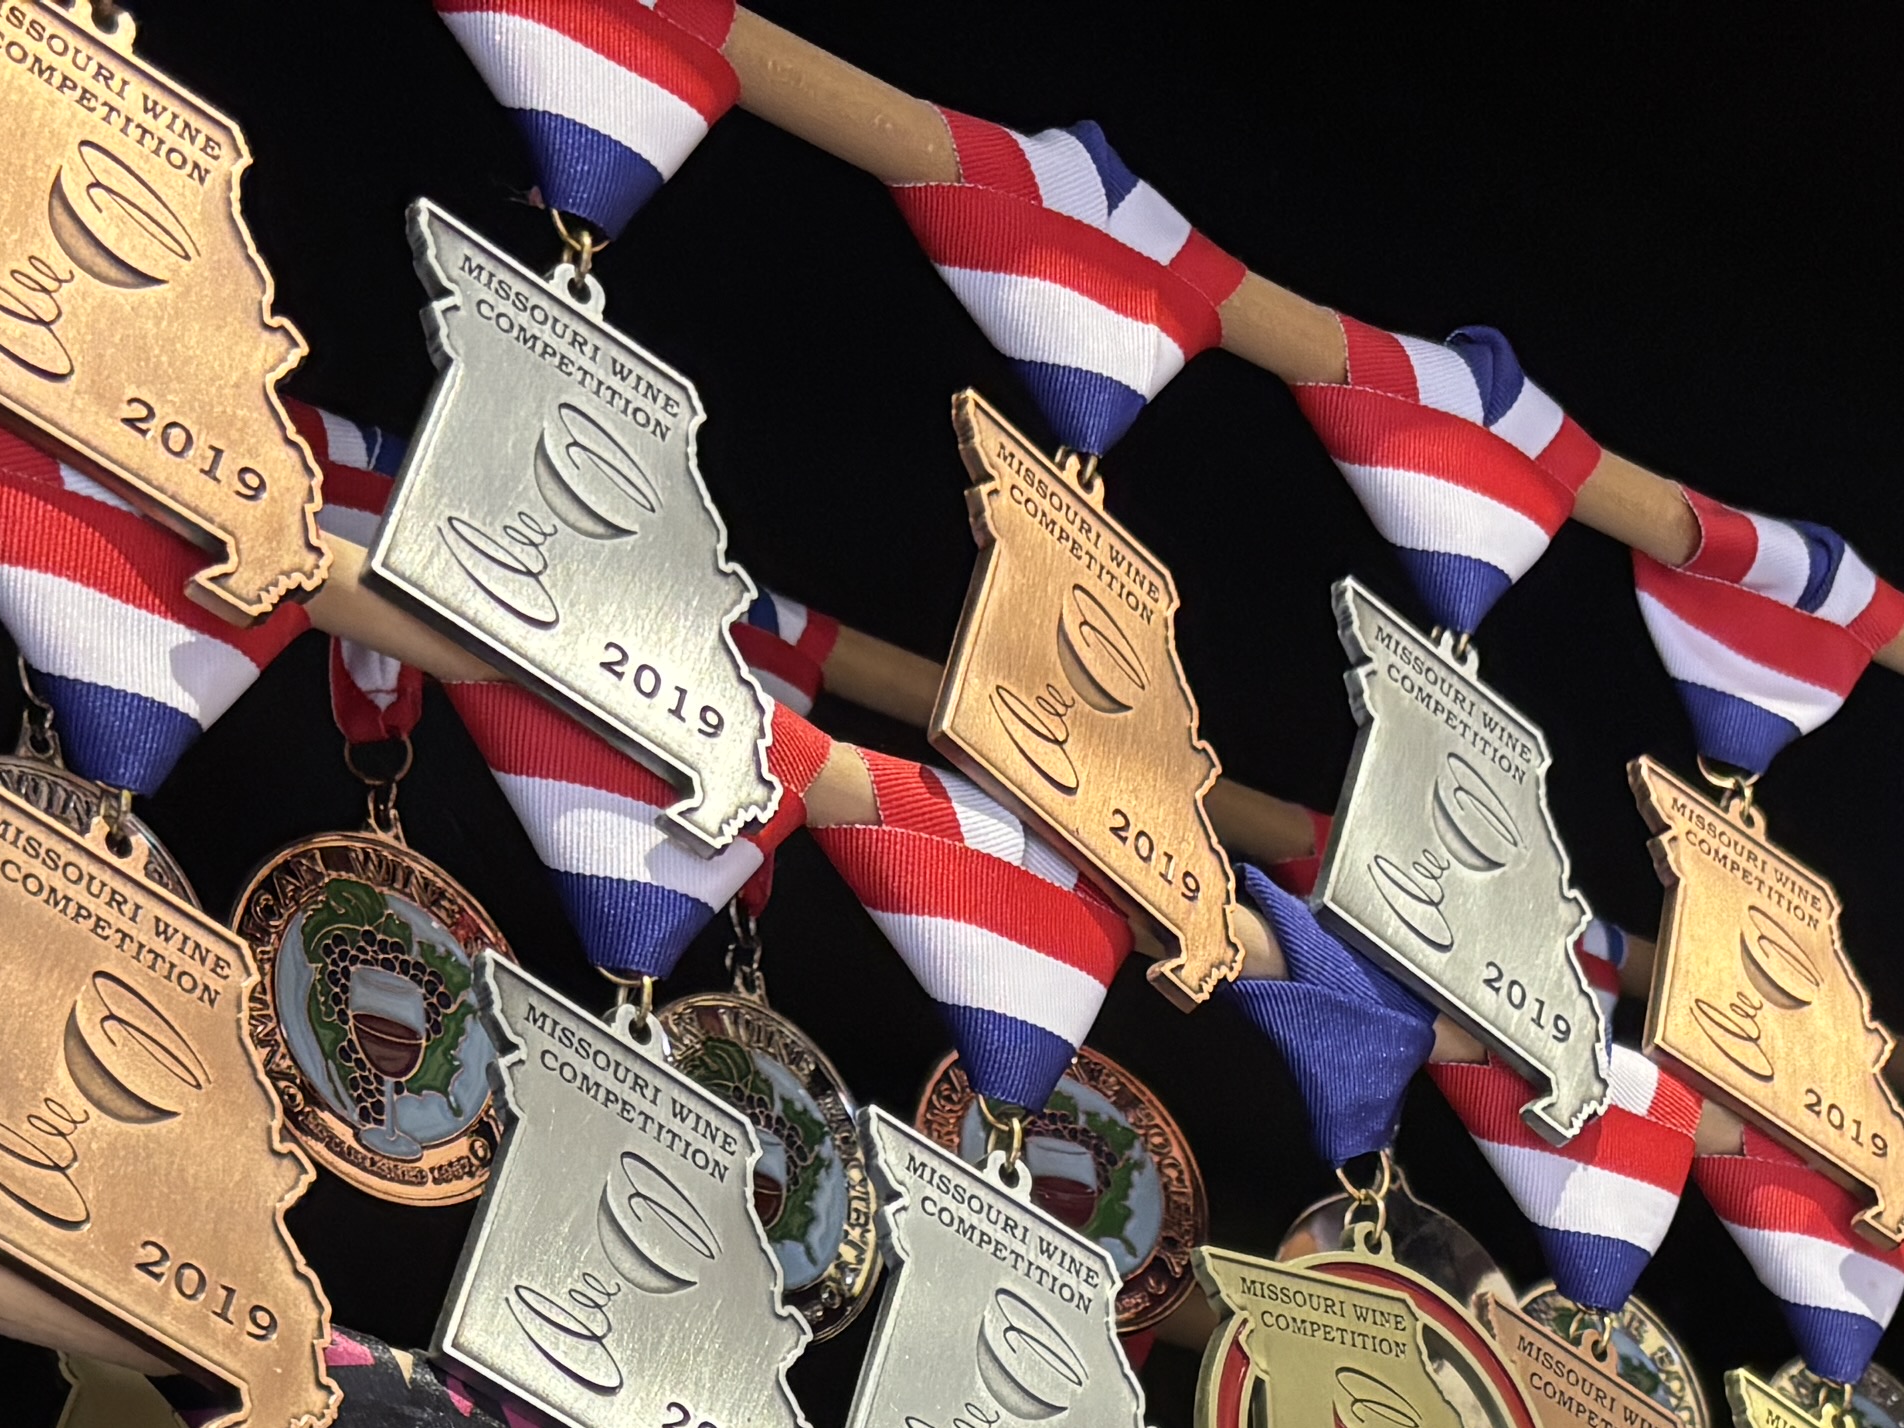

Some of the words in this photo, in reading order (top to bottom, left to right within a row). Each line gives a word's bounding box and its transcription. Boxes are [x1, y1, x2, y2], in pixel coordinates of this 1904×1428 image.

[140, 90, 223, 162] WINE
[458, 252, 602, 366] MISSOURI
[608, 352, 680, 418] WINE
[476, 299, 671, 444] COMPETITION
[119, 397, 269, 504] 2019
[996, 441, 1105, 555] MISSOURI
[1107, 540, 1162, 604] WINE
[1009, 484, 1155, 622] COMPETITION
[598, 642, 726, 740] 2019
[1375, 625, 1479, 719] MISSOURI
[1481, 708, 1532, 762] WINE
[1387, 664, 1527, 785] COMPETITION
[1110, 809, 1201, 902] 2019
[1670, 798, 1768, 870] MISSOURI
[1772, 861, 1823, 911] WINE
[1685, 830, 1819, 931] COMPETITION
[0, 858, 222, 1009] COMPETITION
[152, 910, 232, 981] WINE
[1482, 961, 1572, 1042] 2019
[524, 1003, 663, 1106] MISSOURI
[669, 1094, 738, 1156] WINE
[538, 1050, 731, 1184] COMPETITION
[1804, 1088, 1888, 1158] 2019
[905, 1154, 1032, 1246] MISSOURI
[1037, 1232, 1101, 1289] WINE
[920, 1196, 1094, 1314] COMPETITION
[135, 1241, 278, 1341] 2019
[1239, 1276, 1349, 1321] MISSOURI
[1353, 1304, 1408, 1332] WINE
[1261, 1313, 1408, 1358] COMPETITION
